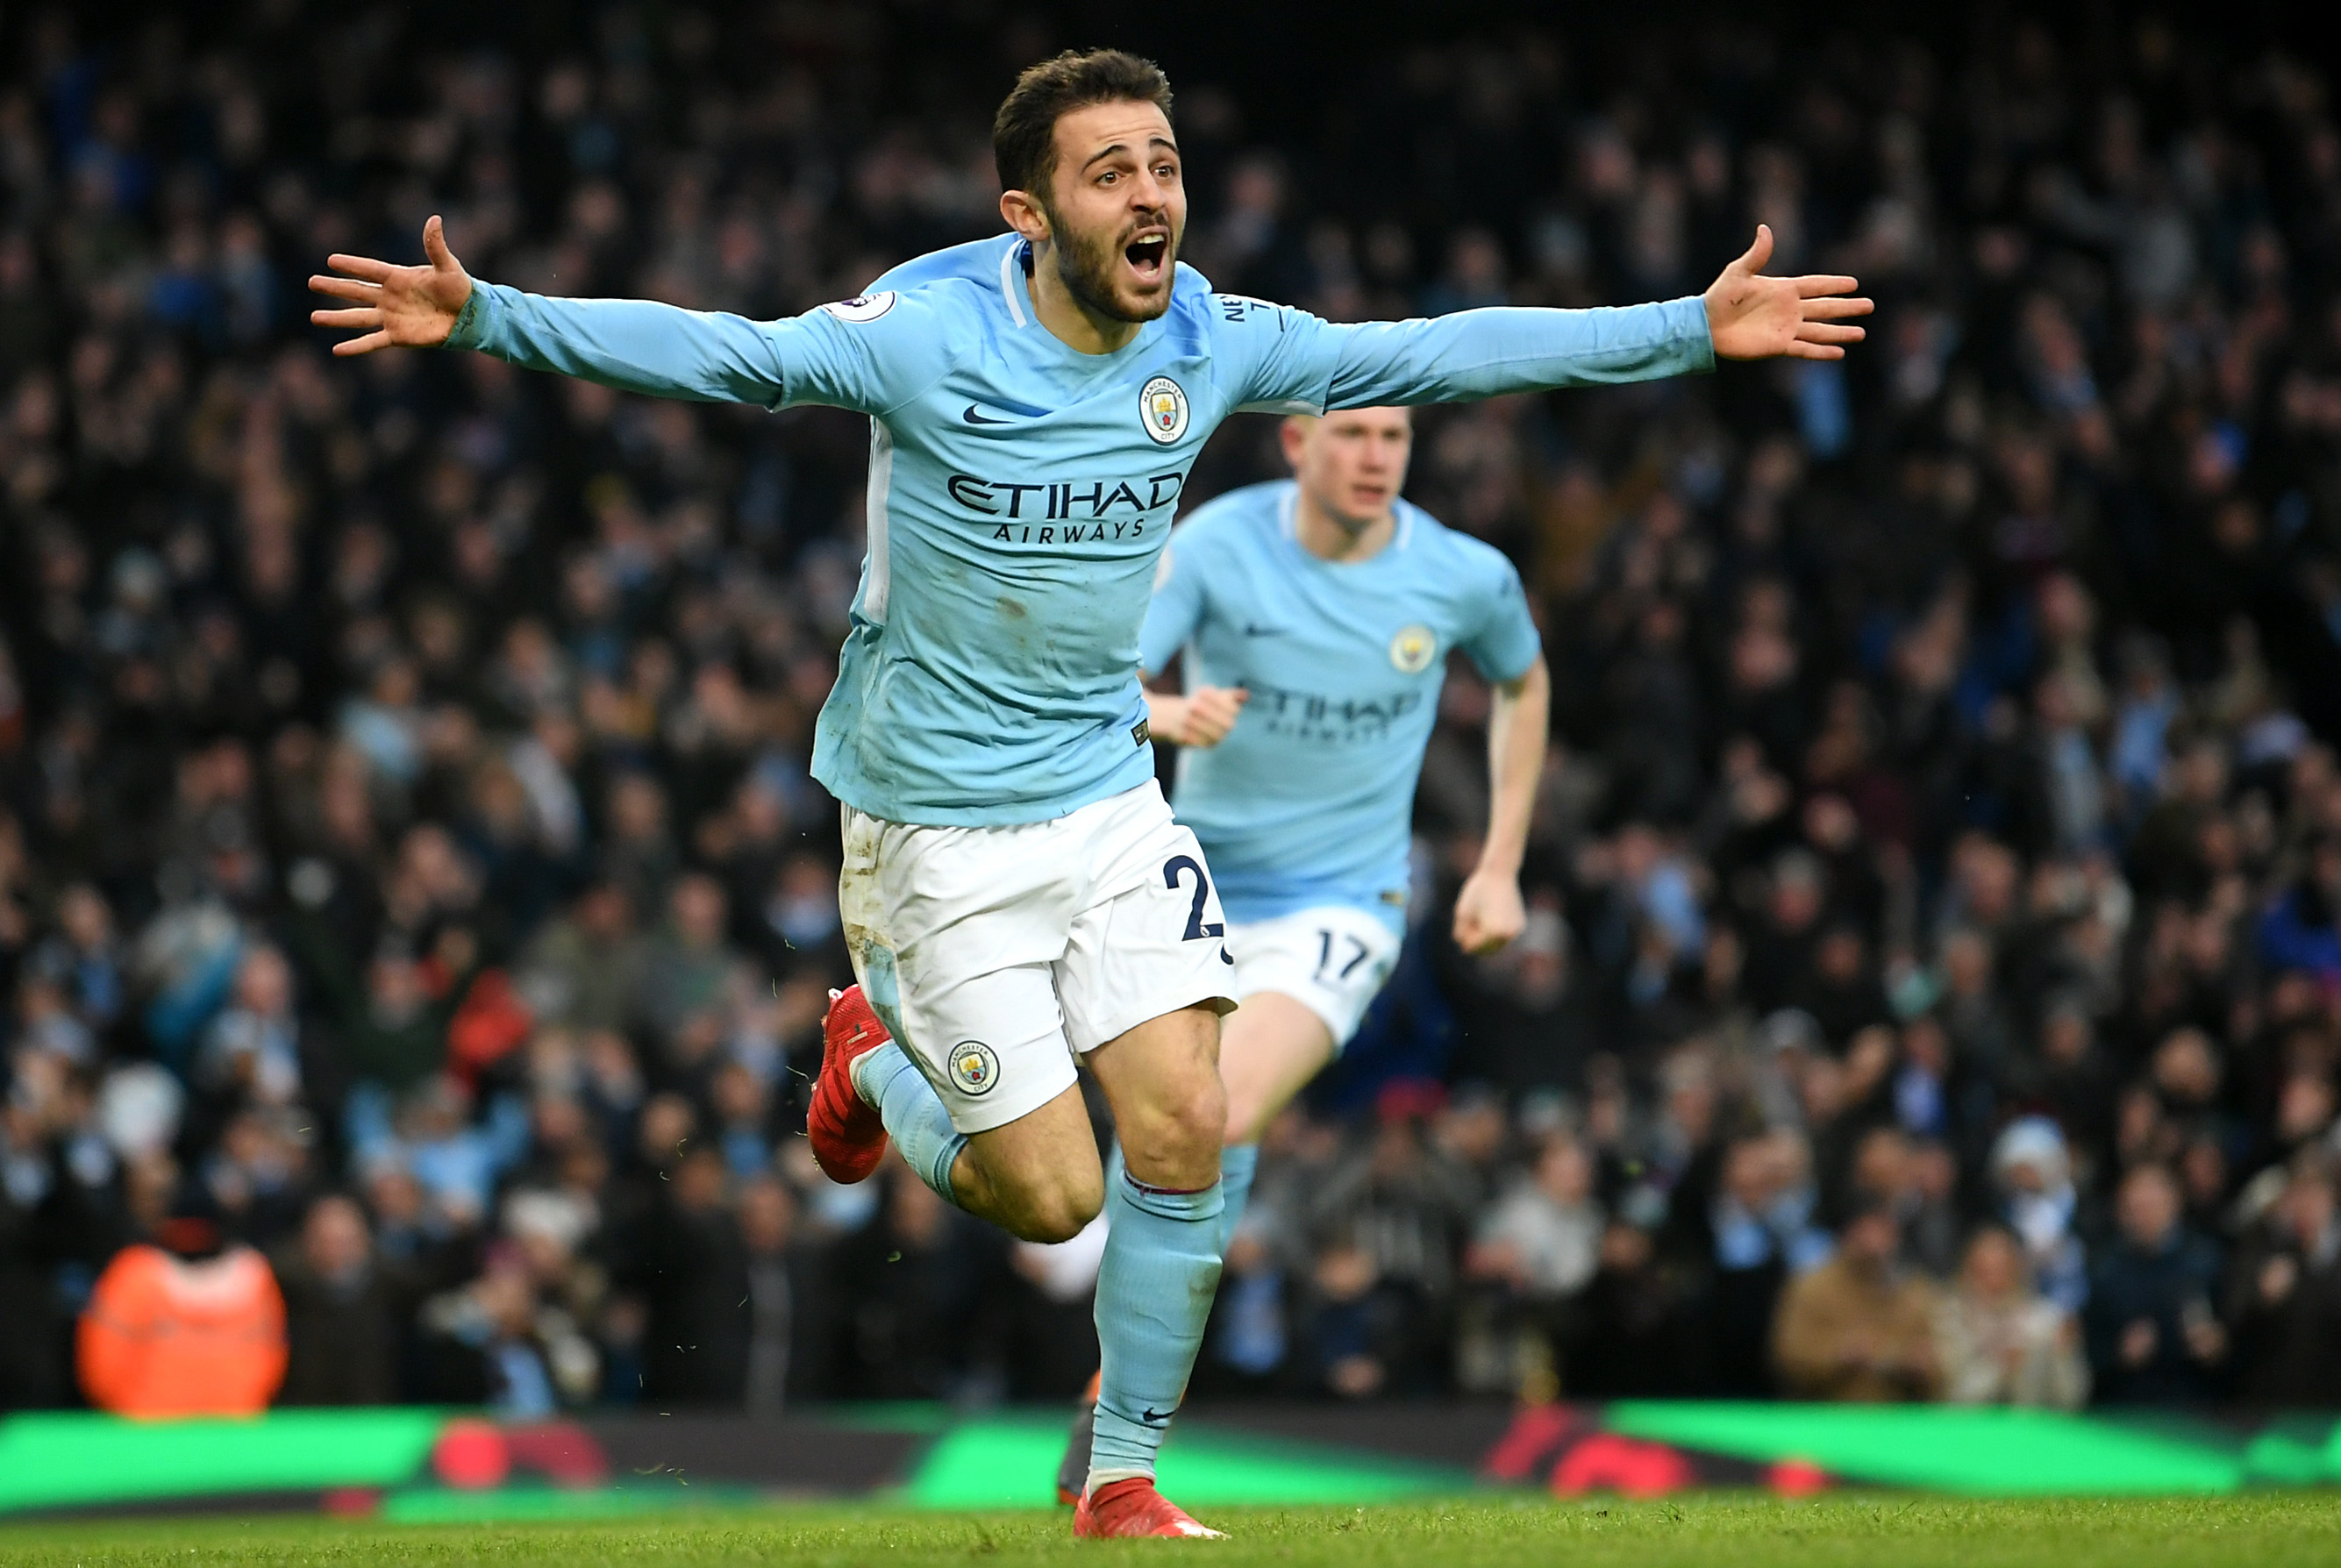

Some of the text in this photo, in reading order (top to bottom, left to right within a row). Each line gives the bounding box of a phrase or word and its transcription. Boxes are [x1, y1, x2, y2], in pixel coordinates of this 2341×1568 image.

[1144, 381, 1182, 403] MANCHESTER
[947, 472, 1184, 519] ETIHAD
[993, 518, 1145, 545] AIRWAYS
[1162, 854, 1235, 966] 2
[1314, 928, 1371, 980] 17
[952, 1044, 989, 1067] MANCHESTER
[974, 1083, 989, 1092] CITY
